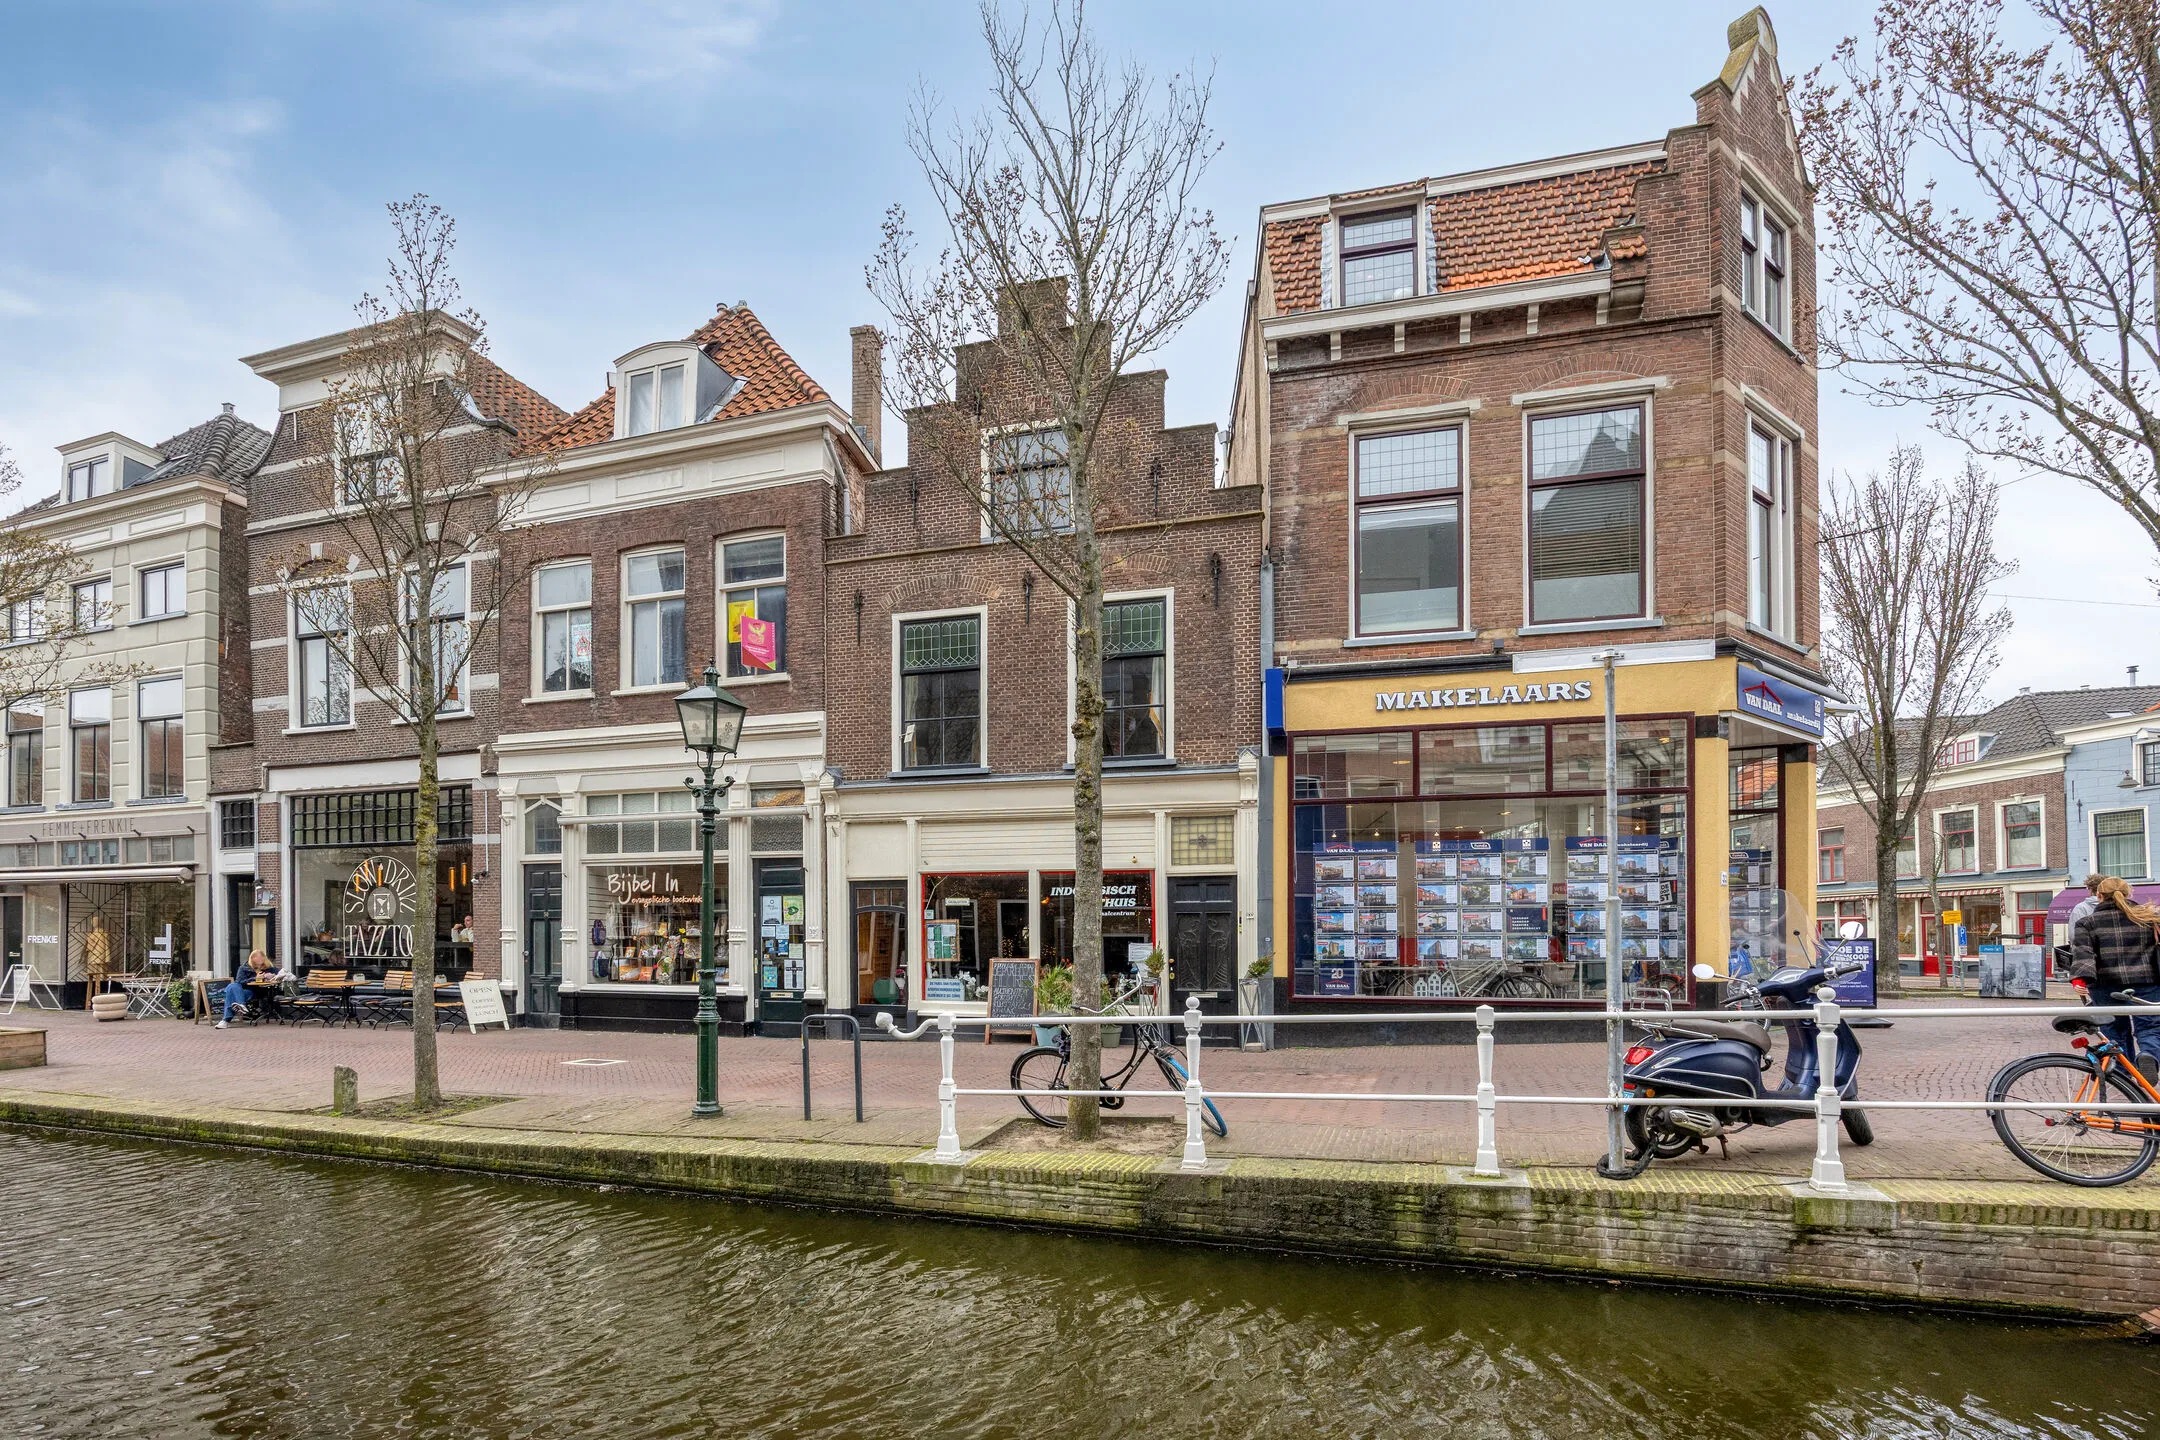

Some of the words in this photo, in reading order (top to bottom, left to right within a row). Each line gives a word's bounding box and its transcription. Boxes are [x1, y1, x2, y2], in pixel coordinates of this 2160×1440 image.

[1376, 681, 1592, 710] MAKELAARS
[1745, 692, 1762, 709] VAN
[1762, 698, 1783, 716] DAAL
[345, 859, 377, 913] SLOW
[607, 871, 656, 905] Bijbel
[665, 872, 679, 892] In
[1050, 885, 1137, 896] INDSISCH
[672, 894, 703, 903] boekwink
[27, 935, 59, 943] FRENKIE
[1855, 946, 1870, 954] DE
[1331, 967, 1344, 979] 20
